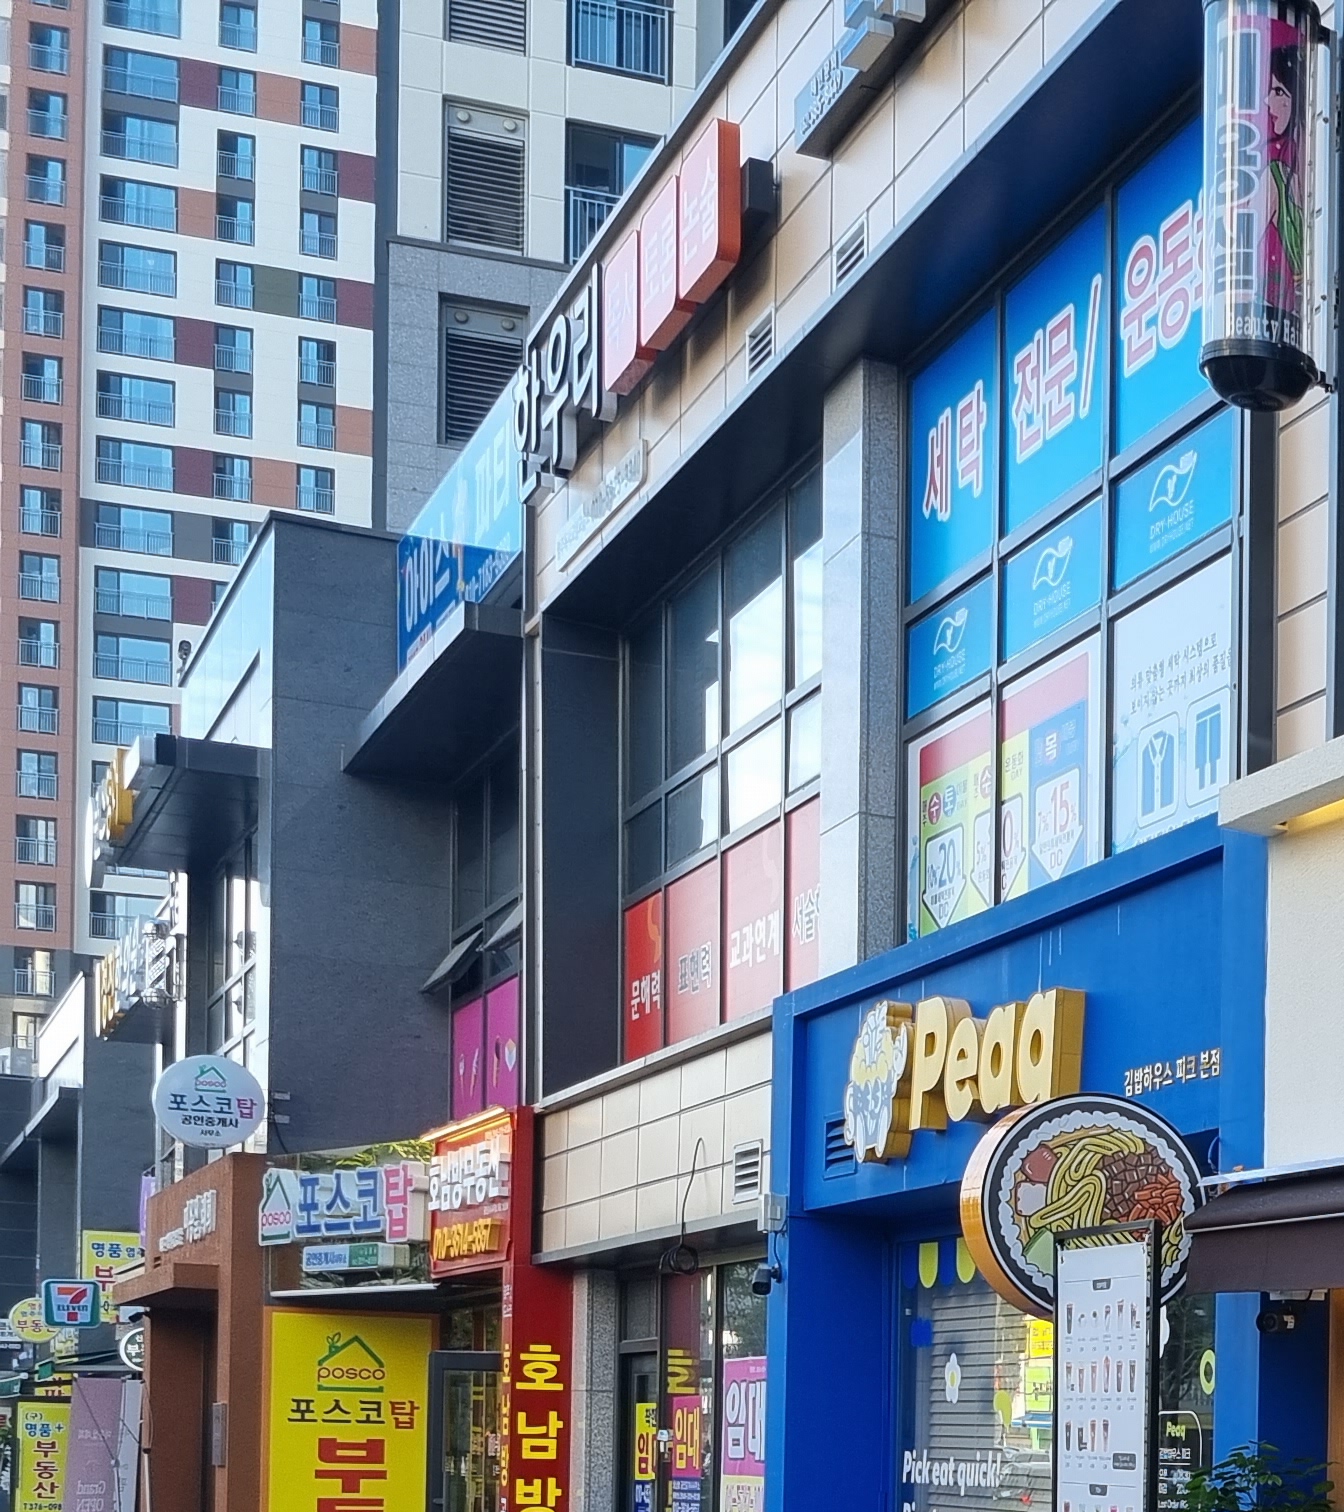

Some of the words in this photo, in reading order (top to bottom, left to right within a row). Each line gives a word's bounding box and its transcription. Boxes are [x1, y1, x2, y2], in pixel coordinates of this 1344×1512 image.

[922, 380, 987, 522] 세탁
[1121, 187, 1204, 378] 운동
[513, 263, 602, 505] 한우리
[729, 907, 781, 970] 교과연계
[677, 941, 713, 996] 표현력
[630, 969, 662, 1021] 문해력
[1123, 1061, 1173, 1098] 김밥하우스
[1200, 1048, 1220, 1080] 본점
[168, 1092, 258, 1120] 포스코탑
[181, 1113, 240, 1129] 공인중개사
[260, 1211, 292, 1228] posco
[294, 1164, 414, 1243] 포스코탑
[91, 1241, 122, 1259] 명품
[57, 1286, 88, 1322] 7
[317, 1366, 386, 1383] posco
[287, 1397, 421, 1430] 포스코탑
[675, 1406, 700, 1470] 임대
[725, 1378, 767, 1462] 임대
[33, 1440, 60, 1500] 부동산
[902, 1449, 932, 1484] Pick
[932, 1456, 955, 1486] eat
[957, 1450, 1002, 1497] quick!
